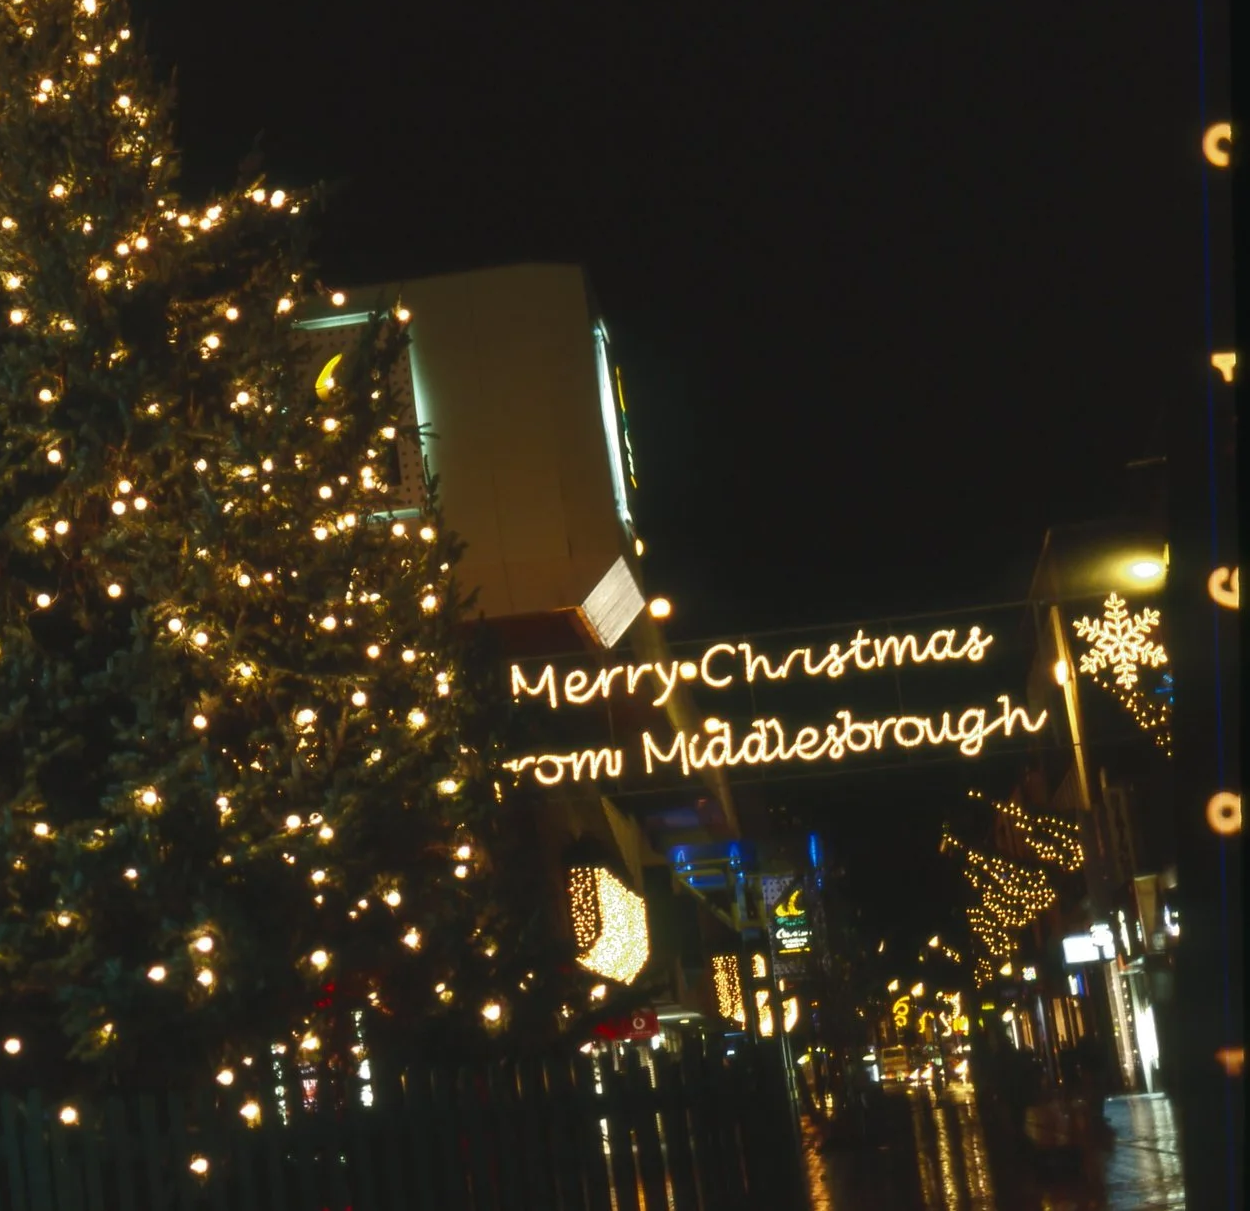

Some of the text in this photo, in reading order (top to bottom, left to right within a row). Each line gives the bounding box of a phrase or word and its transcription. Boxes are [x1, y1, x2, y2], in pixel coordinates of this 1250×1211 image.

[510, 626, 994, 709] Merry Christmas
[501, 694, 1048, 785] rom Middlesbrough
